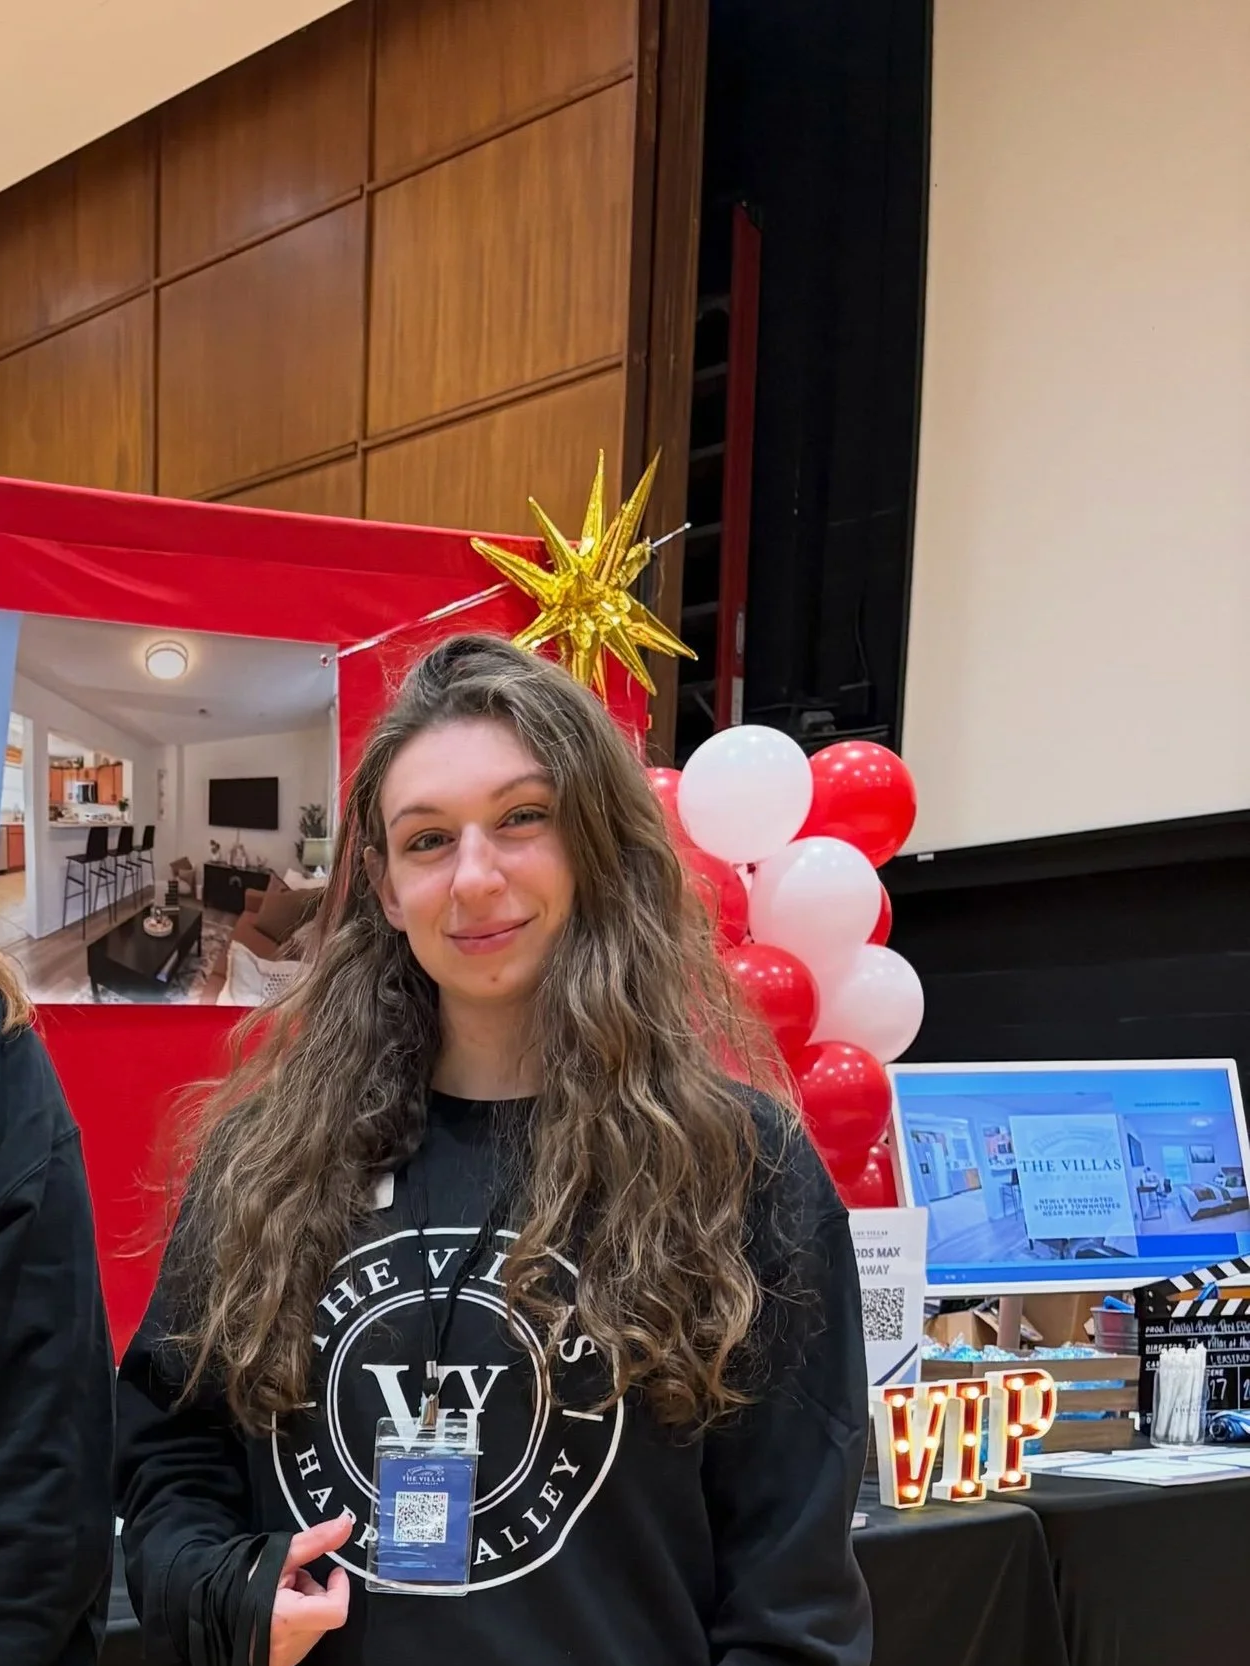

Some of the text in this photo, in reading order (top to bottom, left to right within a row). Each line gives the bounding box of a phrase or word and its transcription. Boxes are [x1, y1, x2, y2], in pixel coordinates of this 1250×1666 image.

[1020, 1158, 1122, 1173] THE VILLAS
[877, 1246, 901, 1258] MAX
[872, 1368, 1057, 1510] VIP
[473, 1448, 581, 1565] ALLEY
